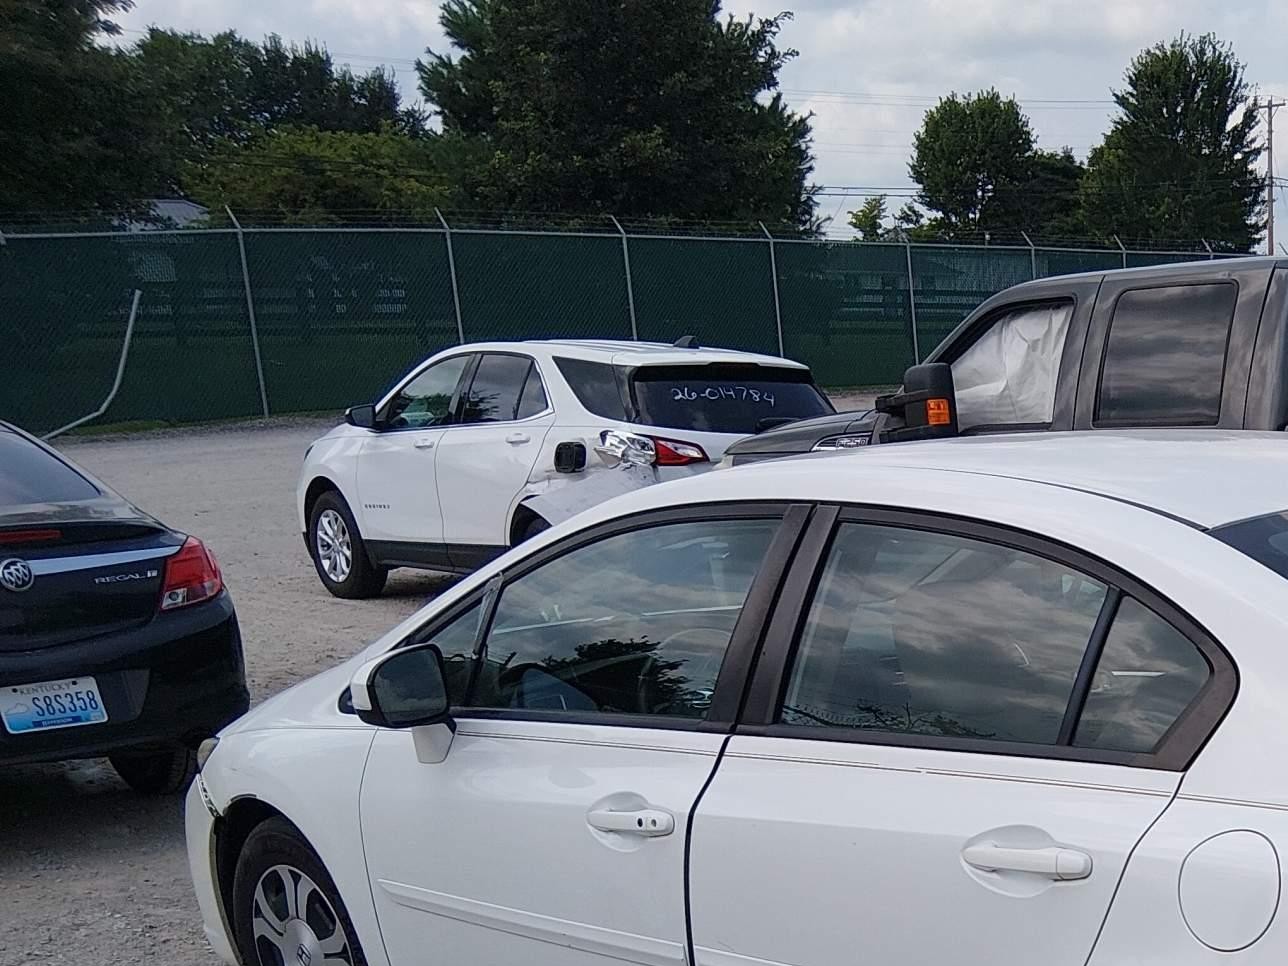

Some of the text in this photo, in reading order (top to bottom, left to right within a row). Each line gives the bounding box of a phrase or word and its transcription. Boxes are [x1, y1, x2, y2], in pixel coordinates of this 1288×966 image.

[672, 386, 775, 407] 26-014784
[94, 573, 146, 584] REGAL
[19, 682, 71, 696] KENTUCKY
[32, 689, 99, 717] S8S358
